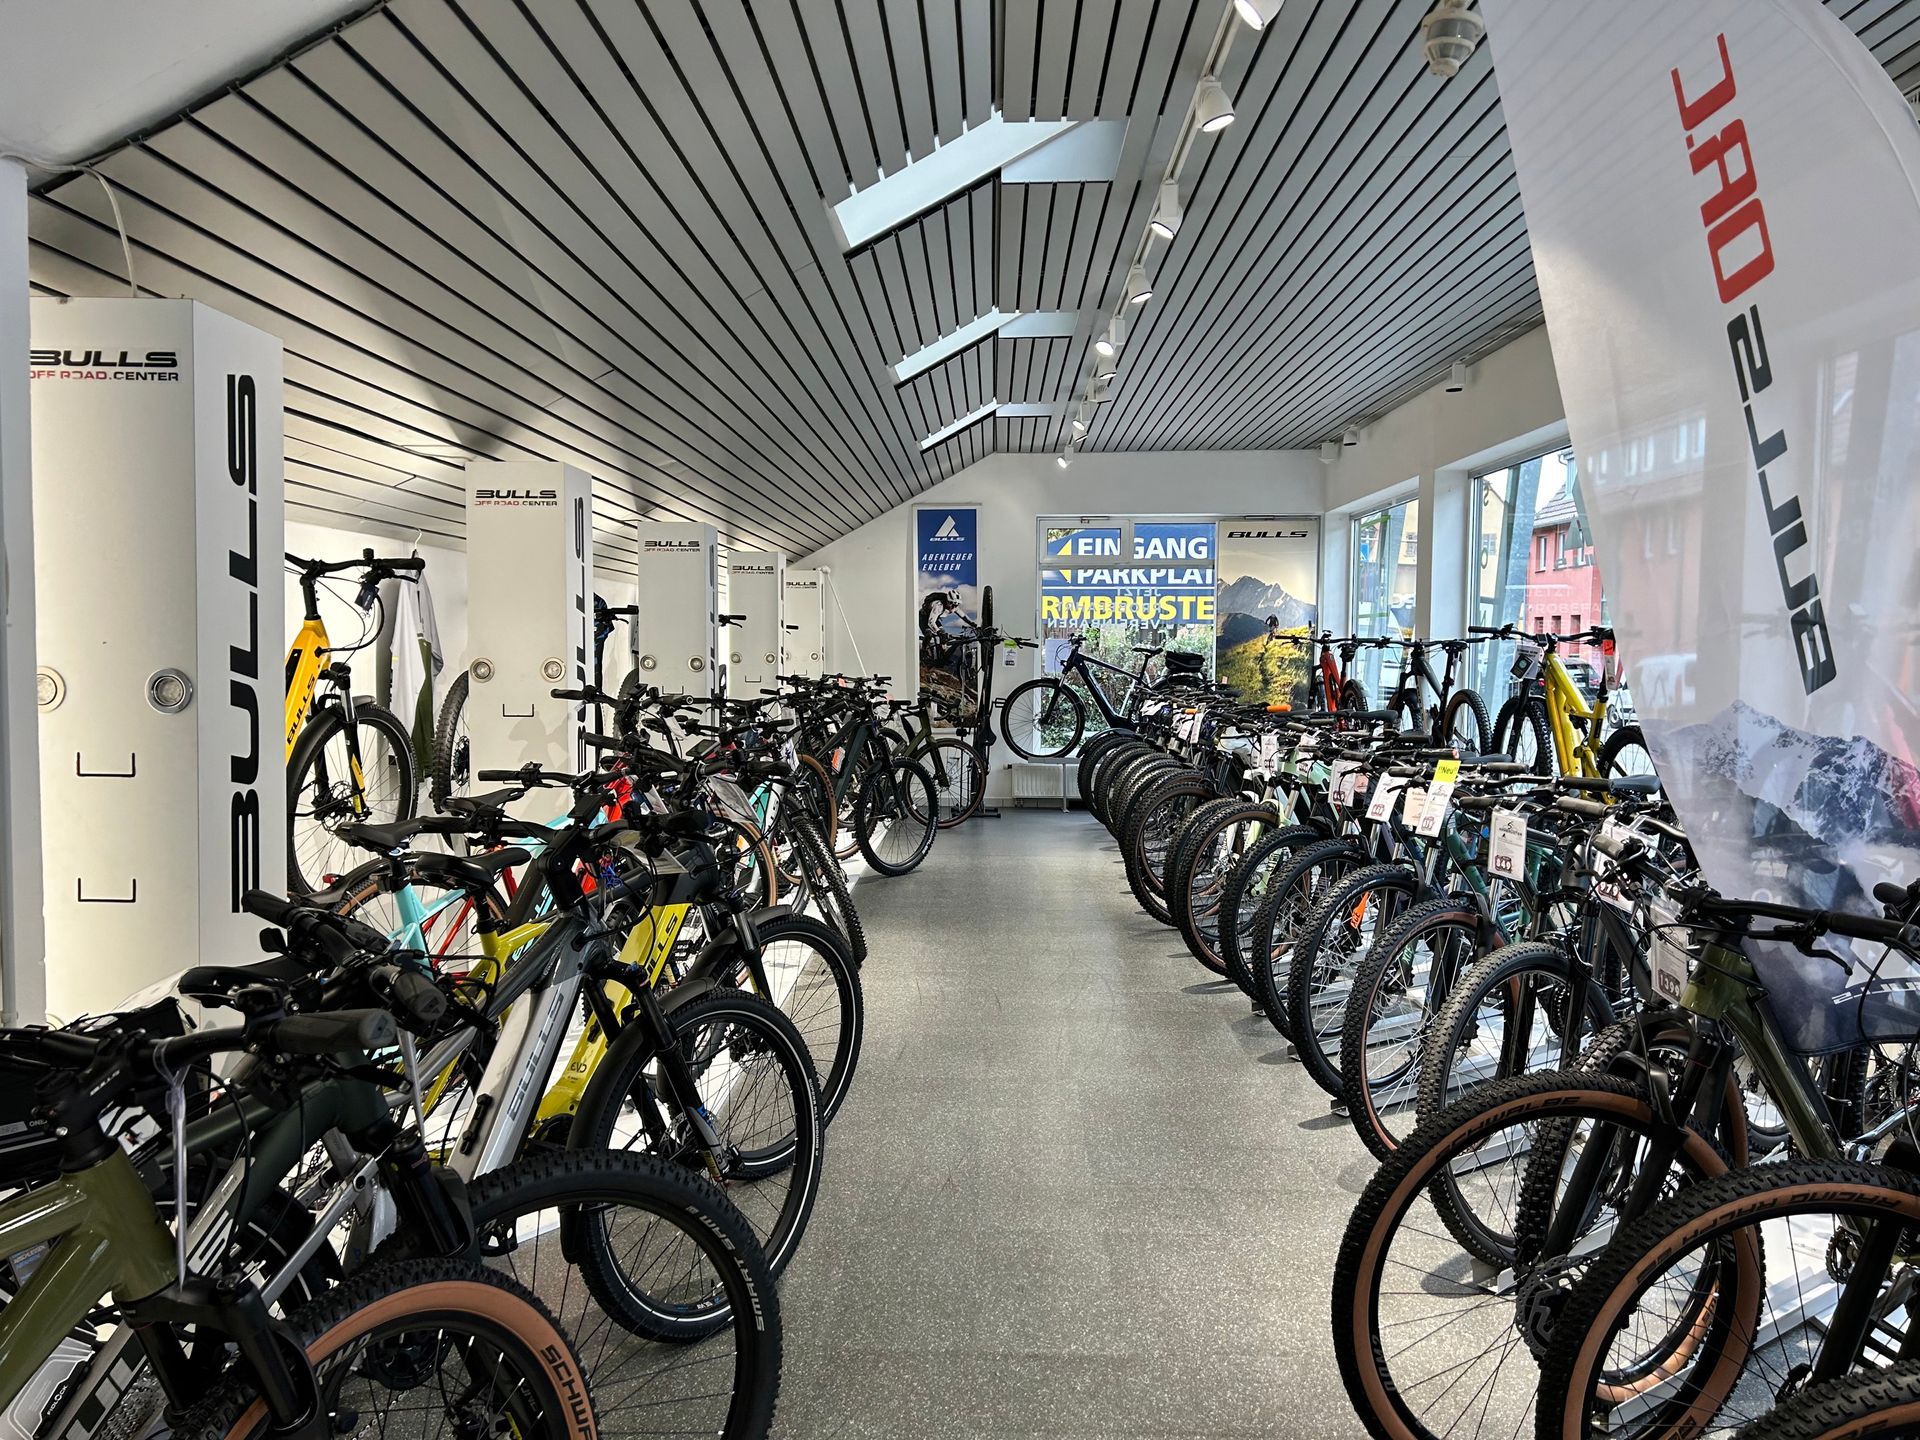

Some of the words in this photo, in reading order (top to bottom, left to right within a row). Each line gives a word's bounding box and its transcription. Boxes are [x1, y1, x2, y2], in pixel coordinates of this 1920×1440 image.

[30, 350, 178, 368] BULLS
[475, 489, 557, 499] BULLS
[1226, 530, 1309, 539] BULLS
[922, 553, 973, 561] ABENTEUER
[922, 563, 961, 571] ERLEBEN
[227, 374, 260, 914] BULLS
[286, 674, 315, 745] BULLS
[507, 993, 565, 1121] BULLS
[1785, 1190, 1902, 1209] RACING
[1682, 1197, 1779, 1246] RALPH
[732, 1255, 765, 1334] SMART
[46, 1385, 69, 1417] FIDLOCK
